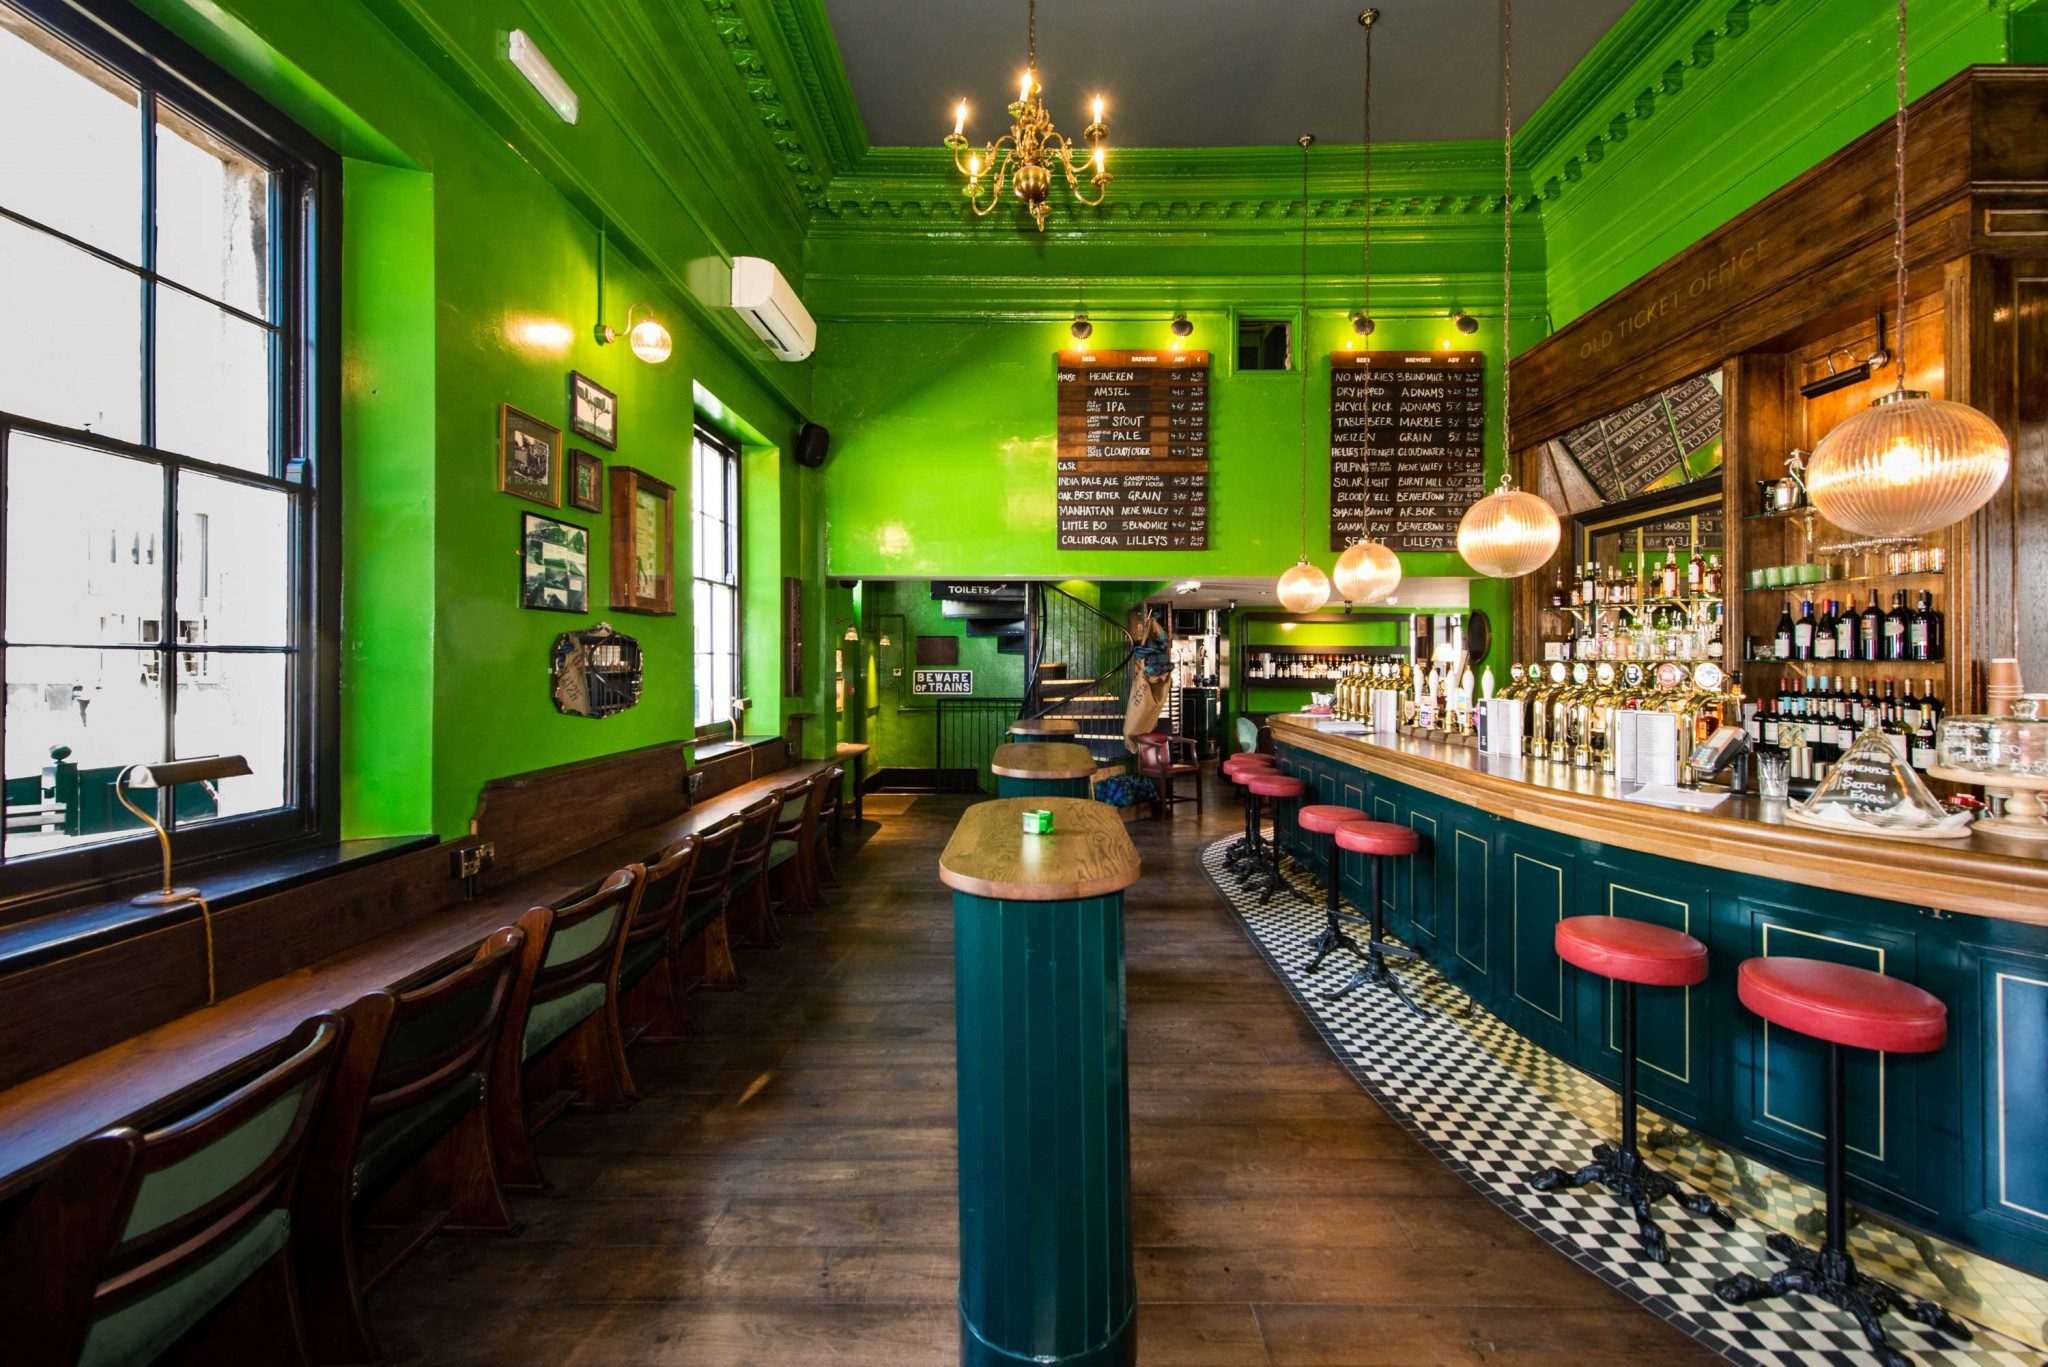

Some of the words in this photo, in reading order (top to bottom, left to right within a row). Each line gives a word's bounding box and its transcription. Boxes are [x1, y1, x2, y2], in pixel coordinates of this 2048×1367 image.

[1581, 331, 1612, 359] OLD
[1618, 289, 1680, 338] TICKET
[1690, 239, 1768, 297] OFFICE
[1058, 373, 1076, 381] HOUSE
[1090, 372, 1134, 381] HEINEKEN
[1335, 373, 1350, 381] NO
[1355, 372, 1394, 381] WORRIES
[1094, 388, 1131, 396] AMSTEL
[1337, 388, 1355, 397] DRY
[1357, 389, 1385, 397] HOPPED
[1402, 389, 1444, 398] ADNAMS
[1107, 402, 1126, 412] IPA
[1335, 402, 1369, 411] BICYCLE
[1372, 402, 1393, 411] KICK
[1400, 402, 1441, 412] ADNAMS
[1446, 402, 1461, 411] 5%
[1112, 416, 1145, 427] STOUT
[1336, 417, 1365, 427] TABLE
[1368, 417, 1394, 426] BEER
[1400, 418, 1442, 427] MARBLE
[1448, 418, 1458, 427] 3%
[1112, 431, 1142, 441] PALE
[1334, 433, 1376, 442] WEIZEN
[1400, 433, 1432, 442] GRAIN
[1448, 432, 1460, 442] 5%
[1398, 447, 1445, 456] CLOUDWATER
[1058, 462, 1076, 470] CASK
[1335, 462, 1369, 473] PULPING
[1398, 463, 1418, 472] NENE
[1420, 463, 1443, 472] VALLEY
[1058, 478, 1079, 486] INDIA
[1081, 477, 1101, 486] PALE
[1103, 478, 1119, 486] ALE
[1333, 477, 1365, 487] SOLAR
[1367, 478, 1390, 487] LIGHT
[1398, 478, 1425, 486] BURNT
[1426, 478, 1442, 487] MILL
[1074, 491, 1092, 500] BEST
[1096, 491, 1120, 500] BITTER
[1128, 491, 1161, 501] GRAIN
[1337, 494, 1369, 502] BLOODY
[1397, 492, 1444, 502] BEAVERTOWN
[1059, 506, 1114, 516] MANHATTAN
[1400, 508, 1437, 517] ARBOR
[1062, 521, 1089, 530] LITTLE
[1093, 521, 1107, 530] BO
[1152, 522, 1168, 530] MICE
[1371, 523, 1390, 532] RAY
[1397, 523, 1444, 532] BEAVERTOWN
[1062, 535, 1099, 545] COLLIDER
[948, 586, 989, 594] TOILETS
[918, 673, 968, 682] BEWARE
[930, 682, 970, 692] TRAINS
[1850, 790, 1886, 804] EGGS
